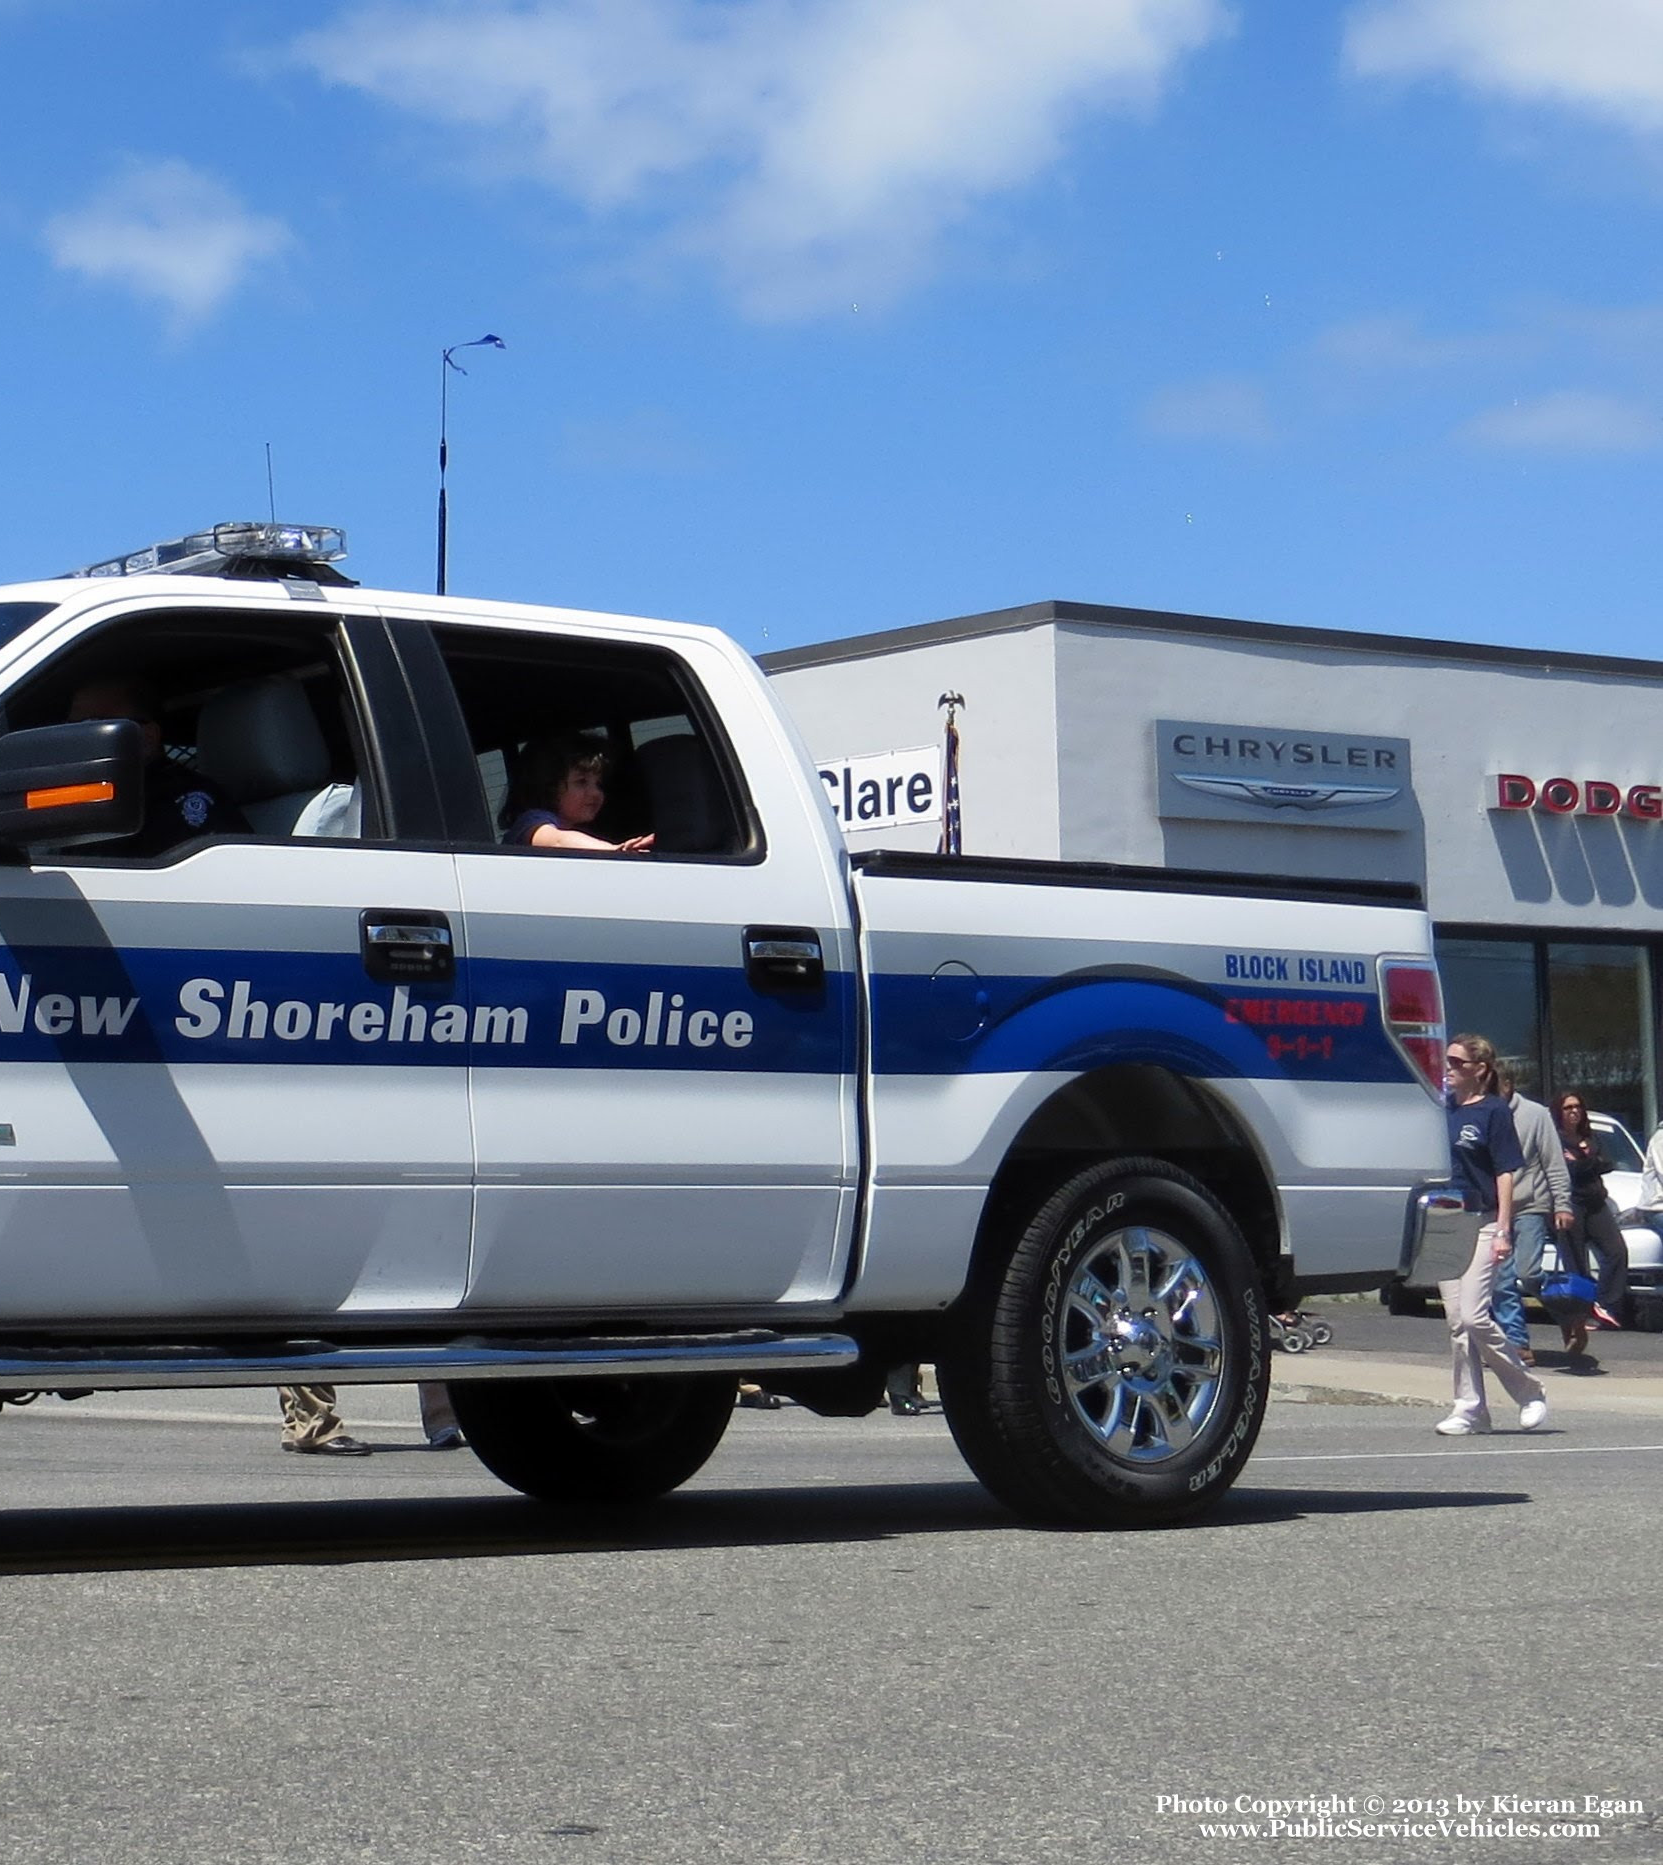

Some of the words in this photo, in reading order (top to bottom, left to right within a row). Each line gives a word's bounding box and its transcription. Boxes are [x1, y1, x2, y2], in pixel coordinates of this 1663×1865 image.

[1173, 734, 1396, 769] CHRYSLER
[1497, 773, 1663, 819] DODG
[1225, 954, 1288, 980] BLOCK
[1299, 958, 1366, 984] ISLAND
[175, 978, 529, 1044] Shoreham
[560, 989, 754, 1048] Police
[1225, 998, 1367, 1026] EMERGENCY
[1040, 1191, 1125, 1405] GOODYEAR
[1188, 1286, 1264, 1492] WRANGLER
